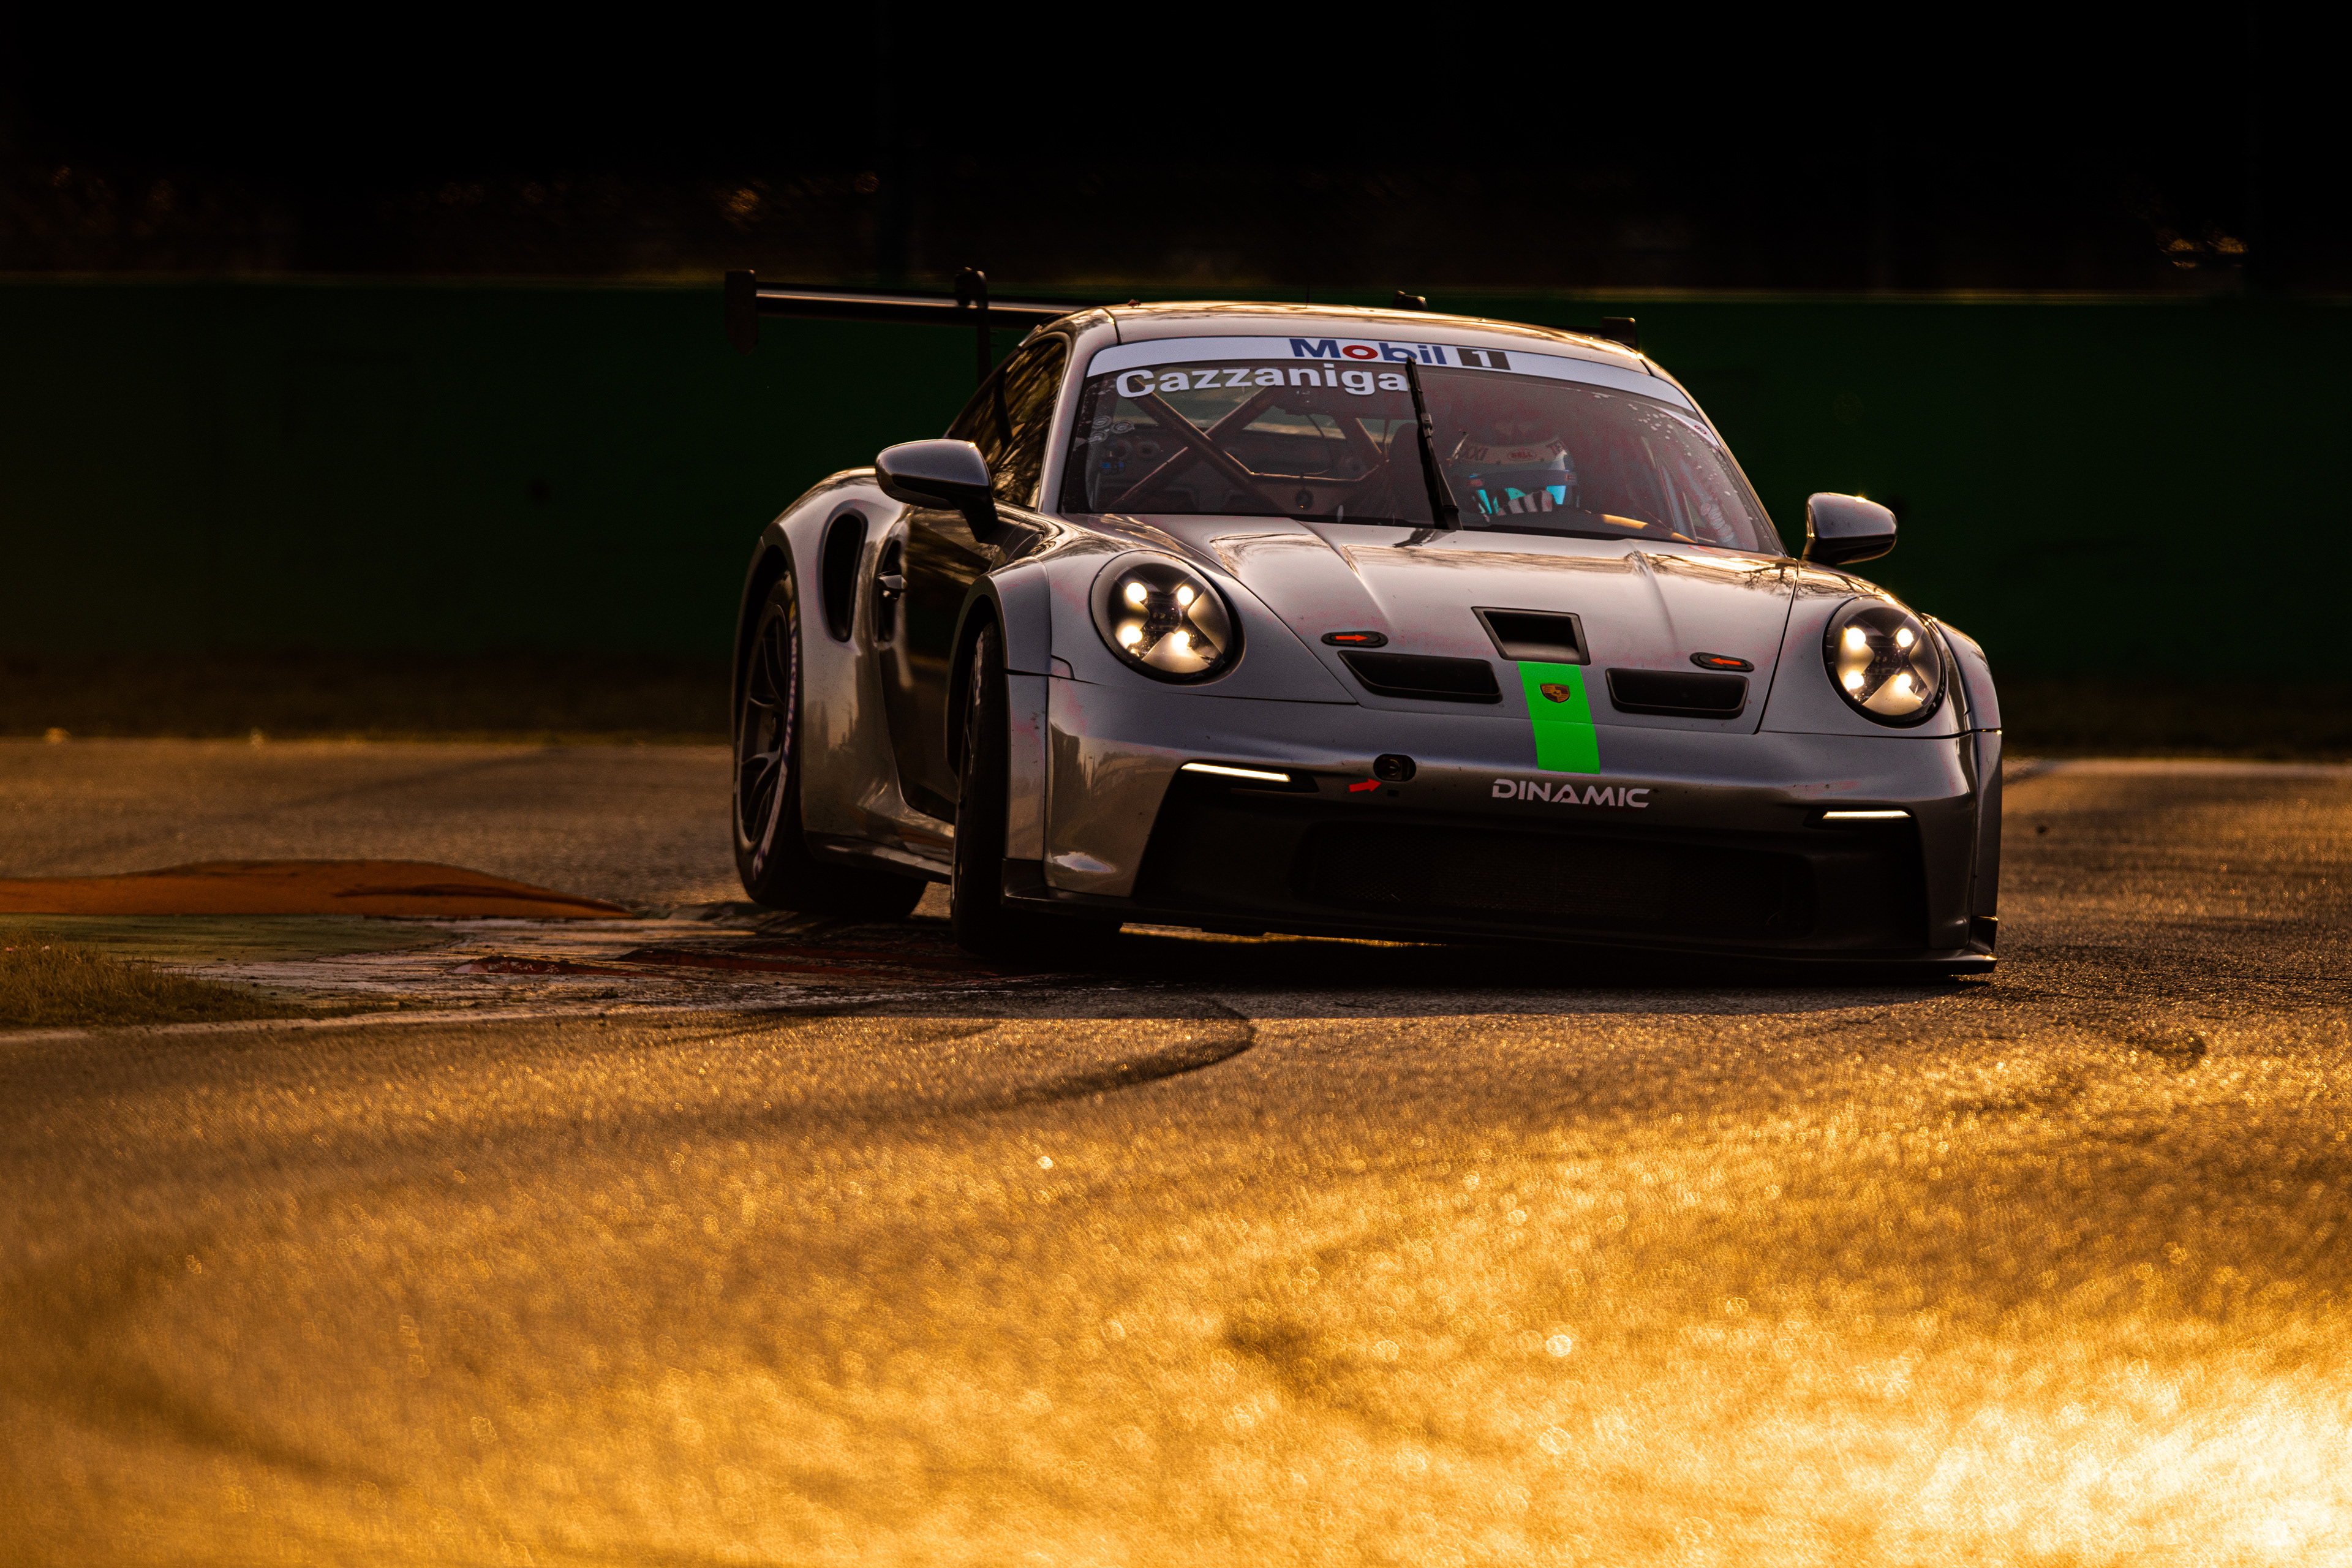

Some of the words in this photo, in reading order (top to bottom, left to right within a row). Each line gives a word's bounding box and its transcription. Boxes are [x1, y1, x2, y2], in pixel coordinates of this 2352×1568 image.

[1289, 338, 1447, 365] Mobil
[1116, 363, 1408, 398] Cazzaniga
[1492, 778, 1650, 808] DINAMIC
